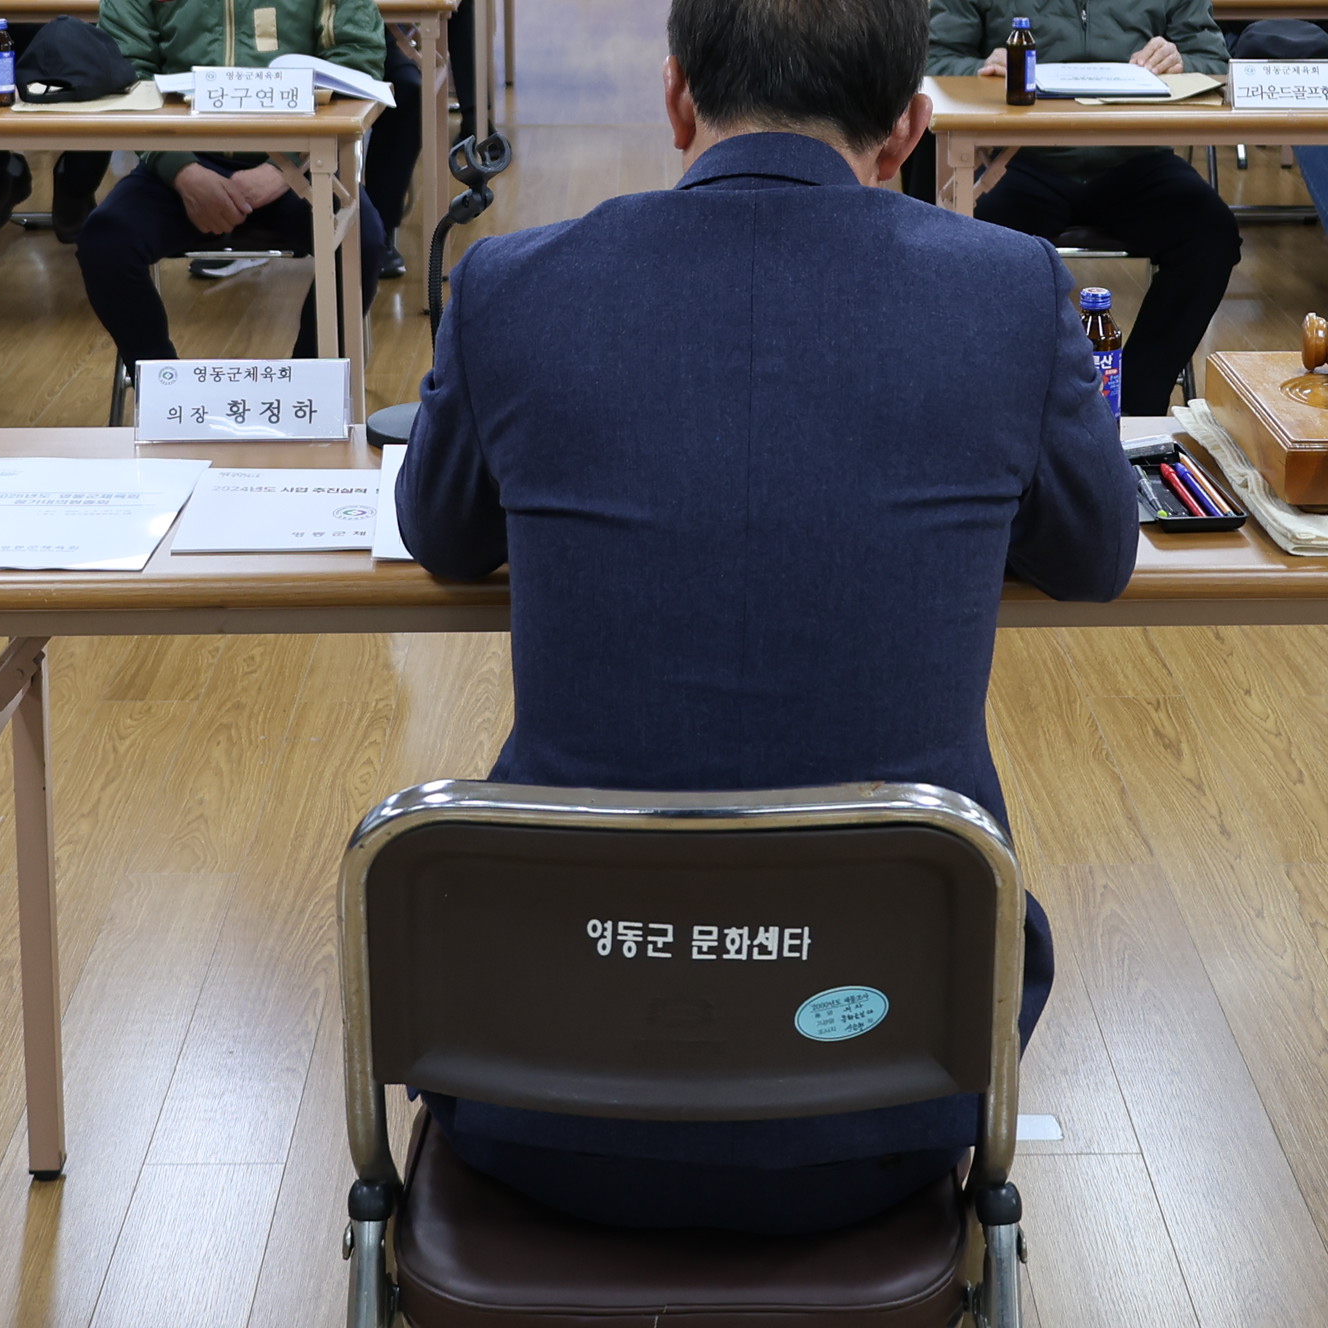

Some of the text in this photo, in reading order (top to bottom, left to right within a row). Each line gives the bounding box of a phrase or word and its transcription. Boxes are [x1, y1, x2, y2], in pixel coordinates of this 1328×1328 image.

[225, 71, 283, 81] 영동군체육회
[207, 86, 299, 109] 당구연맹
[1093, 354, 1113, 369] 론산
[193, 365, 293, 383] 영동군체육회
[586, 918, 812, 961] 영동군 문화센타
